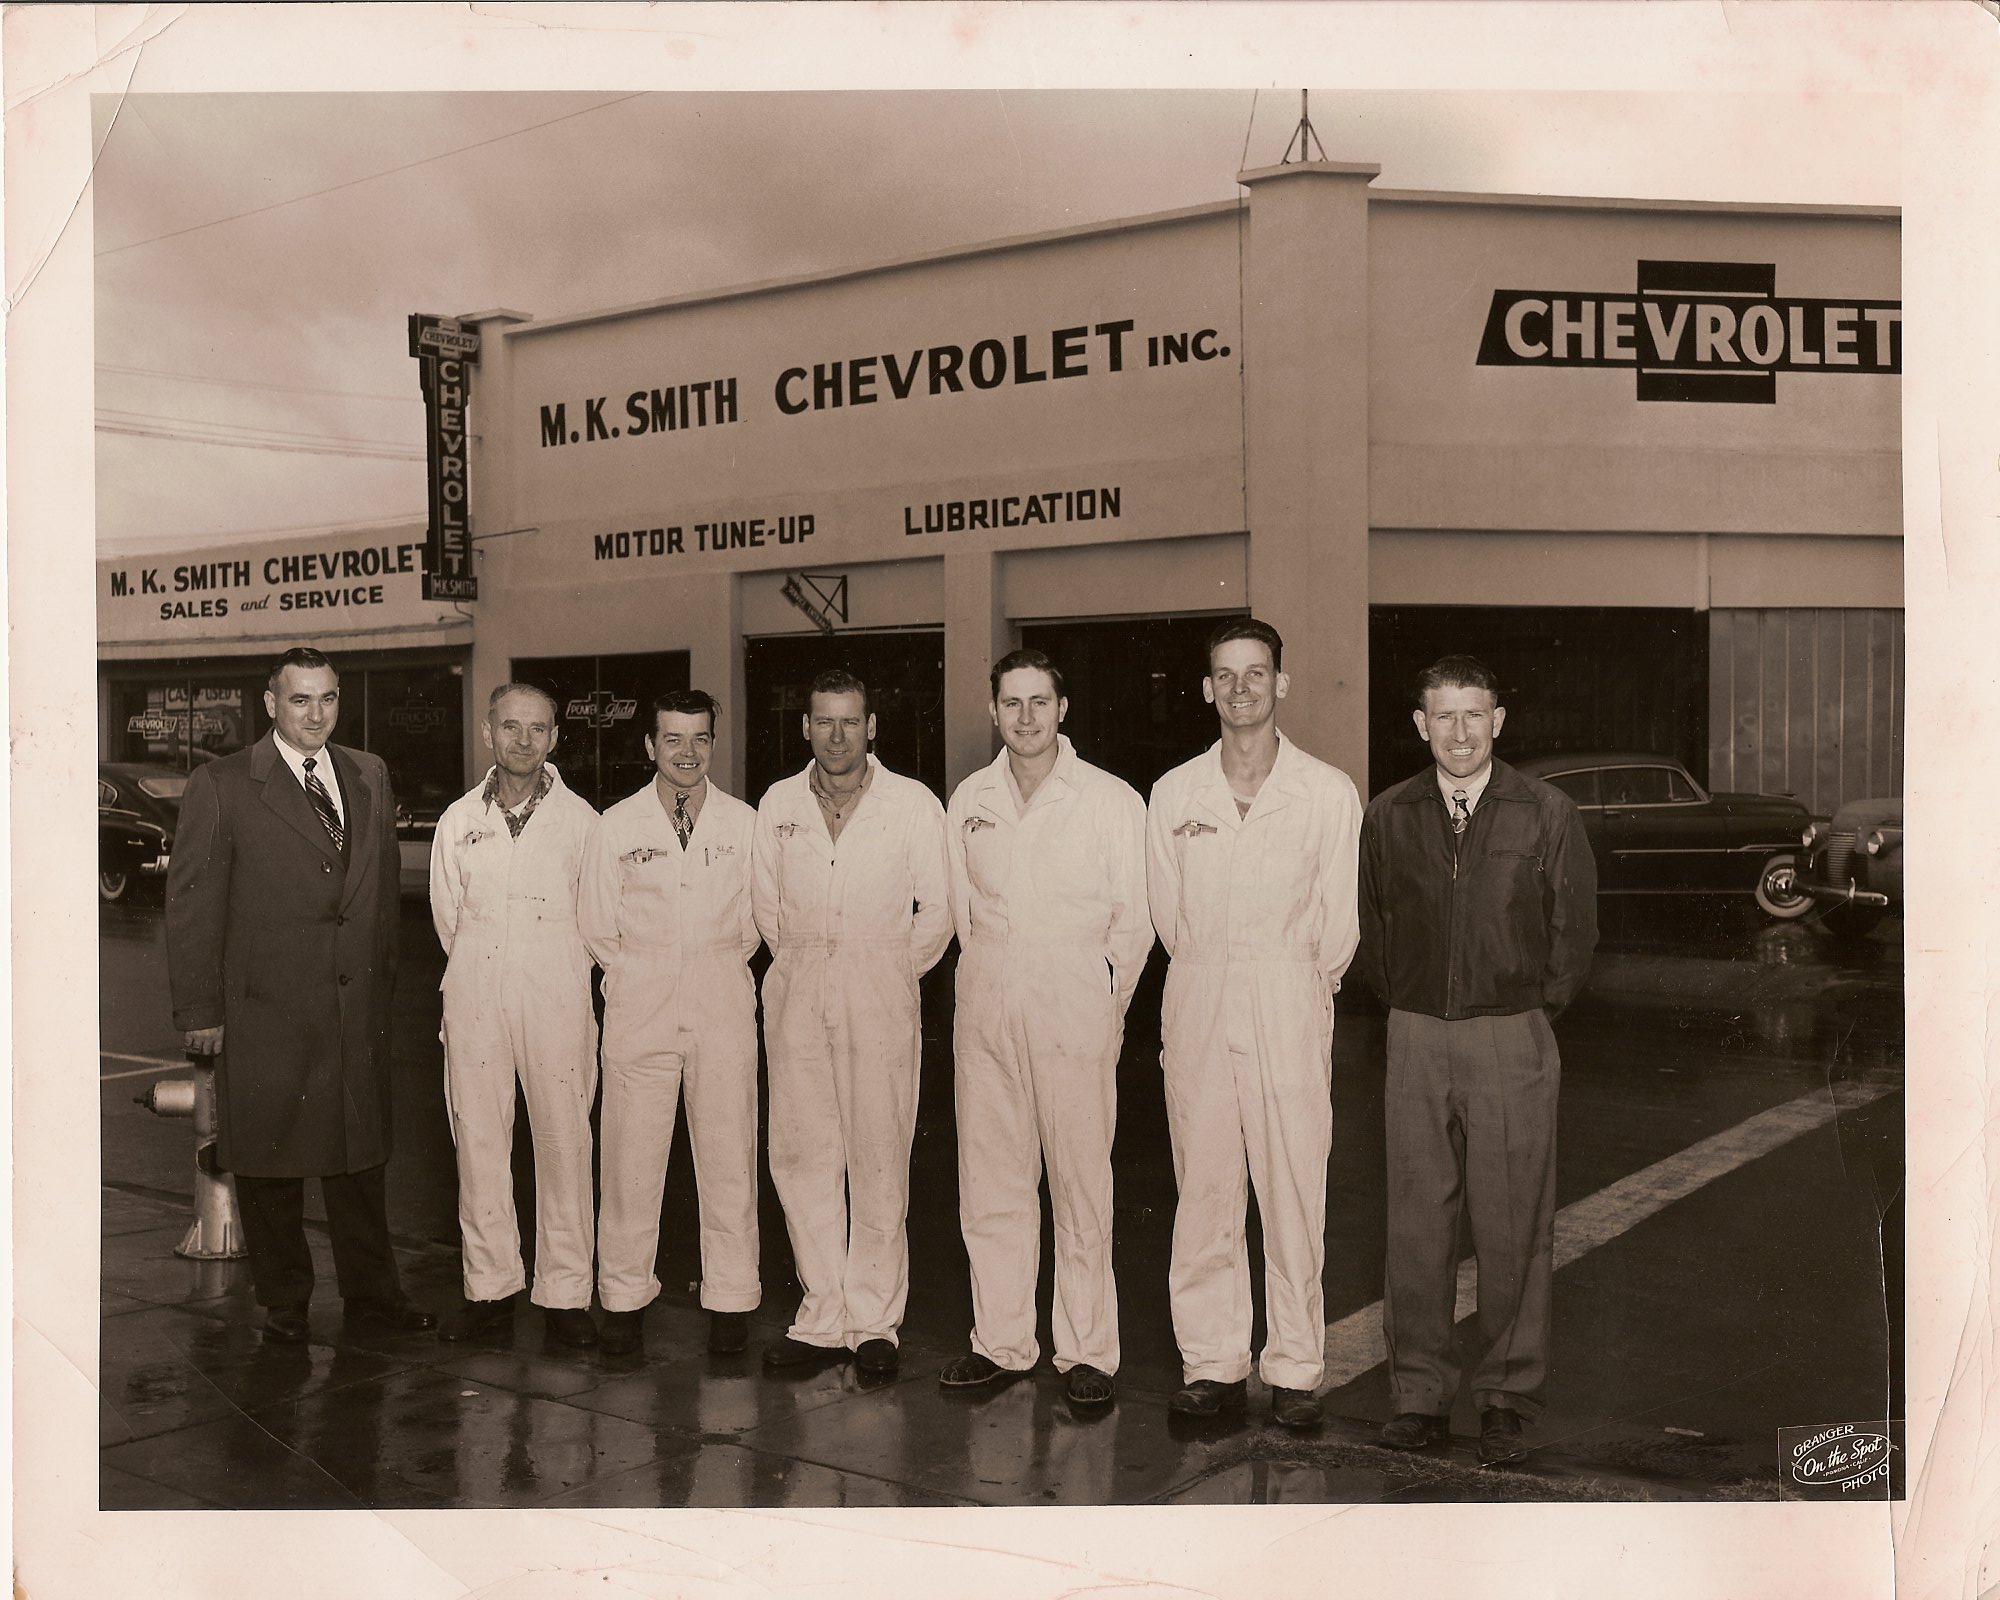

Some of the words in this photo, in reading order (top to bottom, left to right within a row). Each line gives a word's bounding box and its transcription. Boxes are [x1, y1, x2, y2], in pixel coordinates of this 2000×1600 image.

[424, 330, 473, 349] CHEVROLET
[1504, 299, 1902, 366] CHEVROLET
[626, 377, 738, 436] SMITH
[775, 319, 1134, 415] CHEVROLET
[1148, 329, 1231, 367] INC.
[440, 361, 463, 574] CHEVROLET
[904, 487, 1121, 535] LUBRICATION
[594, 527, 685, 560] MOTOR
[694, 514, 815, 551] TUNE-UP
[174, 560, 250, 592] SMITH
[263, 542, 428, 583] CHEVROLET
[160, 598, 229, 620] SALES
[240, 595, 271, 612] and
[279, 585, 384, 611] SERVICE
[131, 718, 174, 730] CHEVROLET
